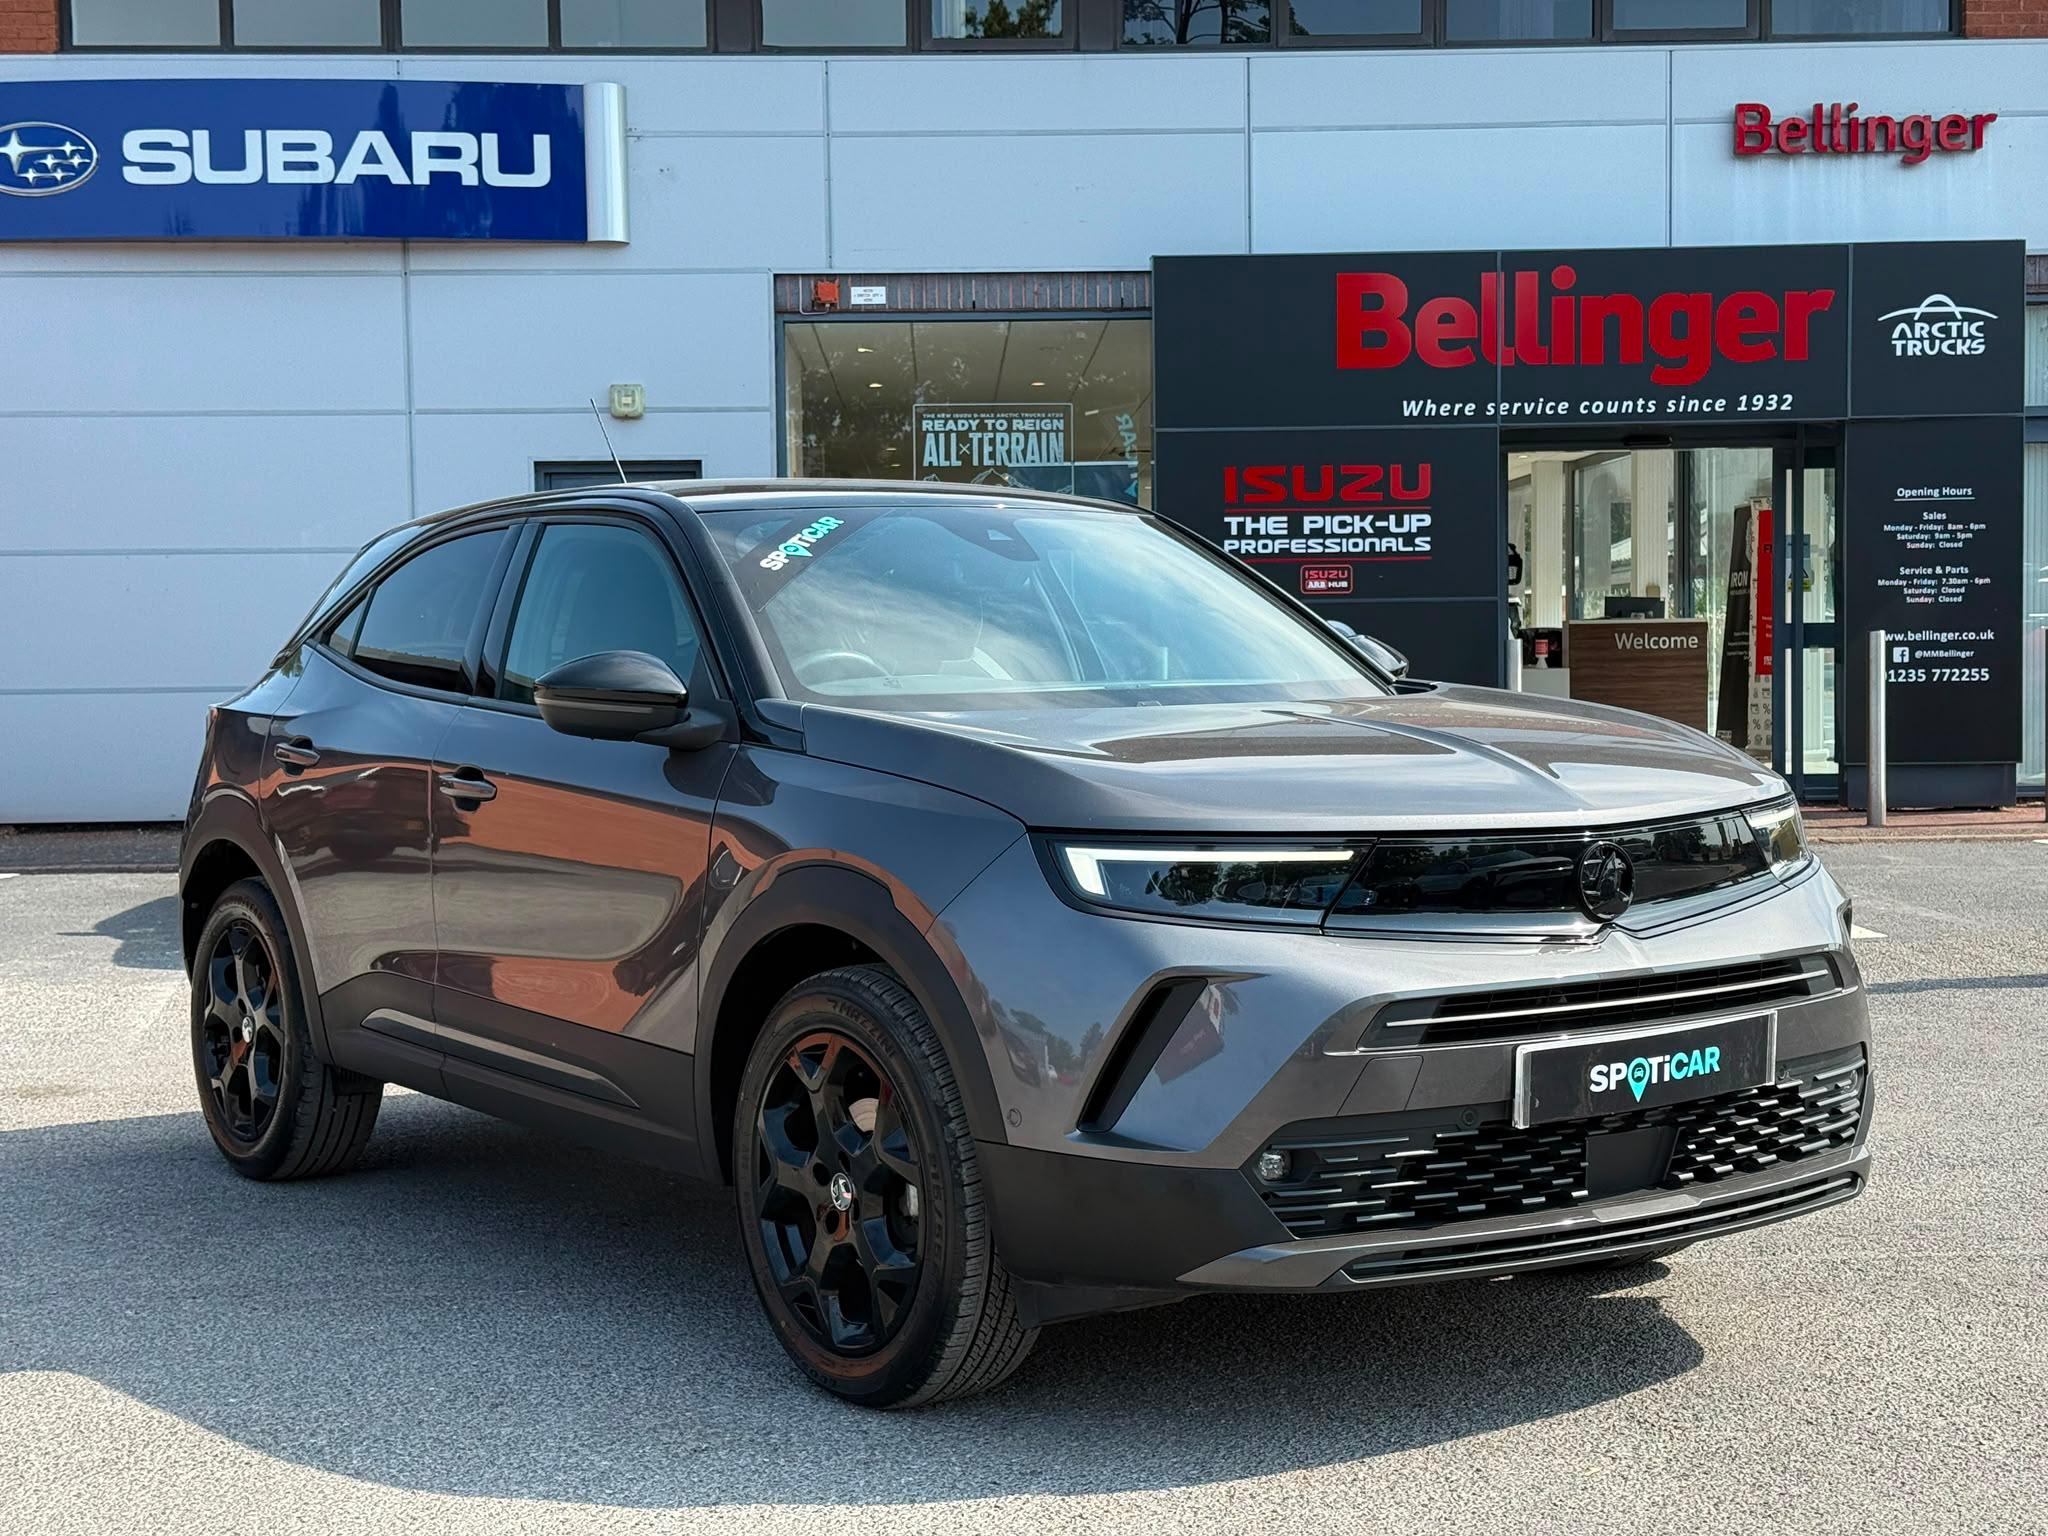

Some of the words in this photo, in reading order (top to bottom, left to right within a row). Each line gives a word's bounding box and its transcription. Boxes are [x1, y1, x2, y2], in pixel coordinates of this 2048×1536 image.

[1733, 102, 1998, 164] Bellinger
[122, 129, 552, 188] SUBARU
[1335, 265, 1836, 387] Bellinger
[1891, 321, 1985, 339] ARCTIC
[1891, 339, 1986, 356] TRUCKS
[1402, 399, 1476, 417] Where
[1486, 397, 1569, 416] service
[1579, 397, 1656, 414] counts
[1666, 395, 1727, 413] since
[1737, 394, 1794, 412] 1932
[922, 419, 980, 431] READY
[984, 419, 1008, 431] TO
[1012, 419, 1064, 430] REIGN
[923, 432, 962, 467] ALL
[969, 432, 1064, 467] TERRAIN
[1223, 464, 1432, 504] ISUZU
[1896, 487, 1940, 498] Opening
[1942, 487, 1973, 496] Hours
[1923, 512, 1947, 520] Sales
[1223, 516, 1289, 536] THE
[1303, 514, 1432, 535] PICK-UP
[1883, 524, 1913, 533] Monday
[1919, 523, 1944, 531] Friday:
[1970, 523, 1986, 531] 6pm
[1896, 533, 1931, 541] Saturday:
[1957, 532, 1973, 540] 5pm
[1223, 537, 1432, 554] PROFESSIONALS
[1906, 542, 1935, 550] Sunday:
[1305, 570, 1348, 579] ISUZU
[1899, 566, 1933, 575] Service
[1945, 566, 1969, 574] Parts
[1913, 578, 1938, 586] Friday:
[1974, 577, 1991, 585] 6pm
[1903, 587, 1937, 595] Saturday:
[1941, 586, 1965, 594] Closed
[1906, 596, 1935, 604] Sunday:
[1614, 632, 1699, 650] Welcome
[1885, 629, 1995, 643] ww.bellinger.co.uk
[1914, 650, 1975, 659] @MMBellinger
[1884, 669, 1926, 682] 1235
[1931, 668, 1990, 682] 772255
